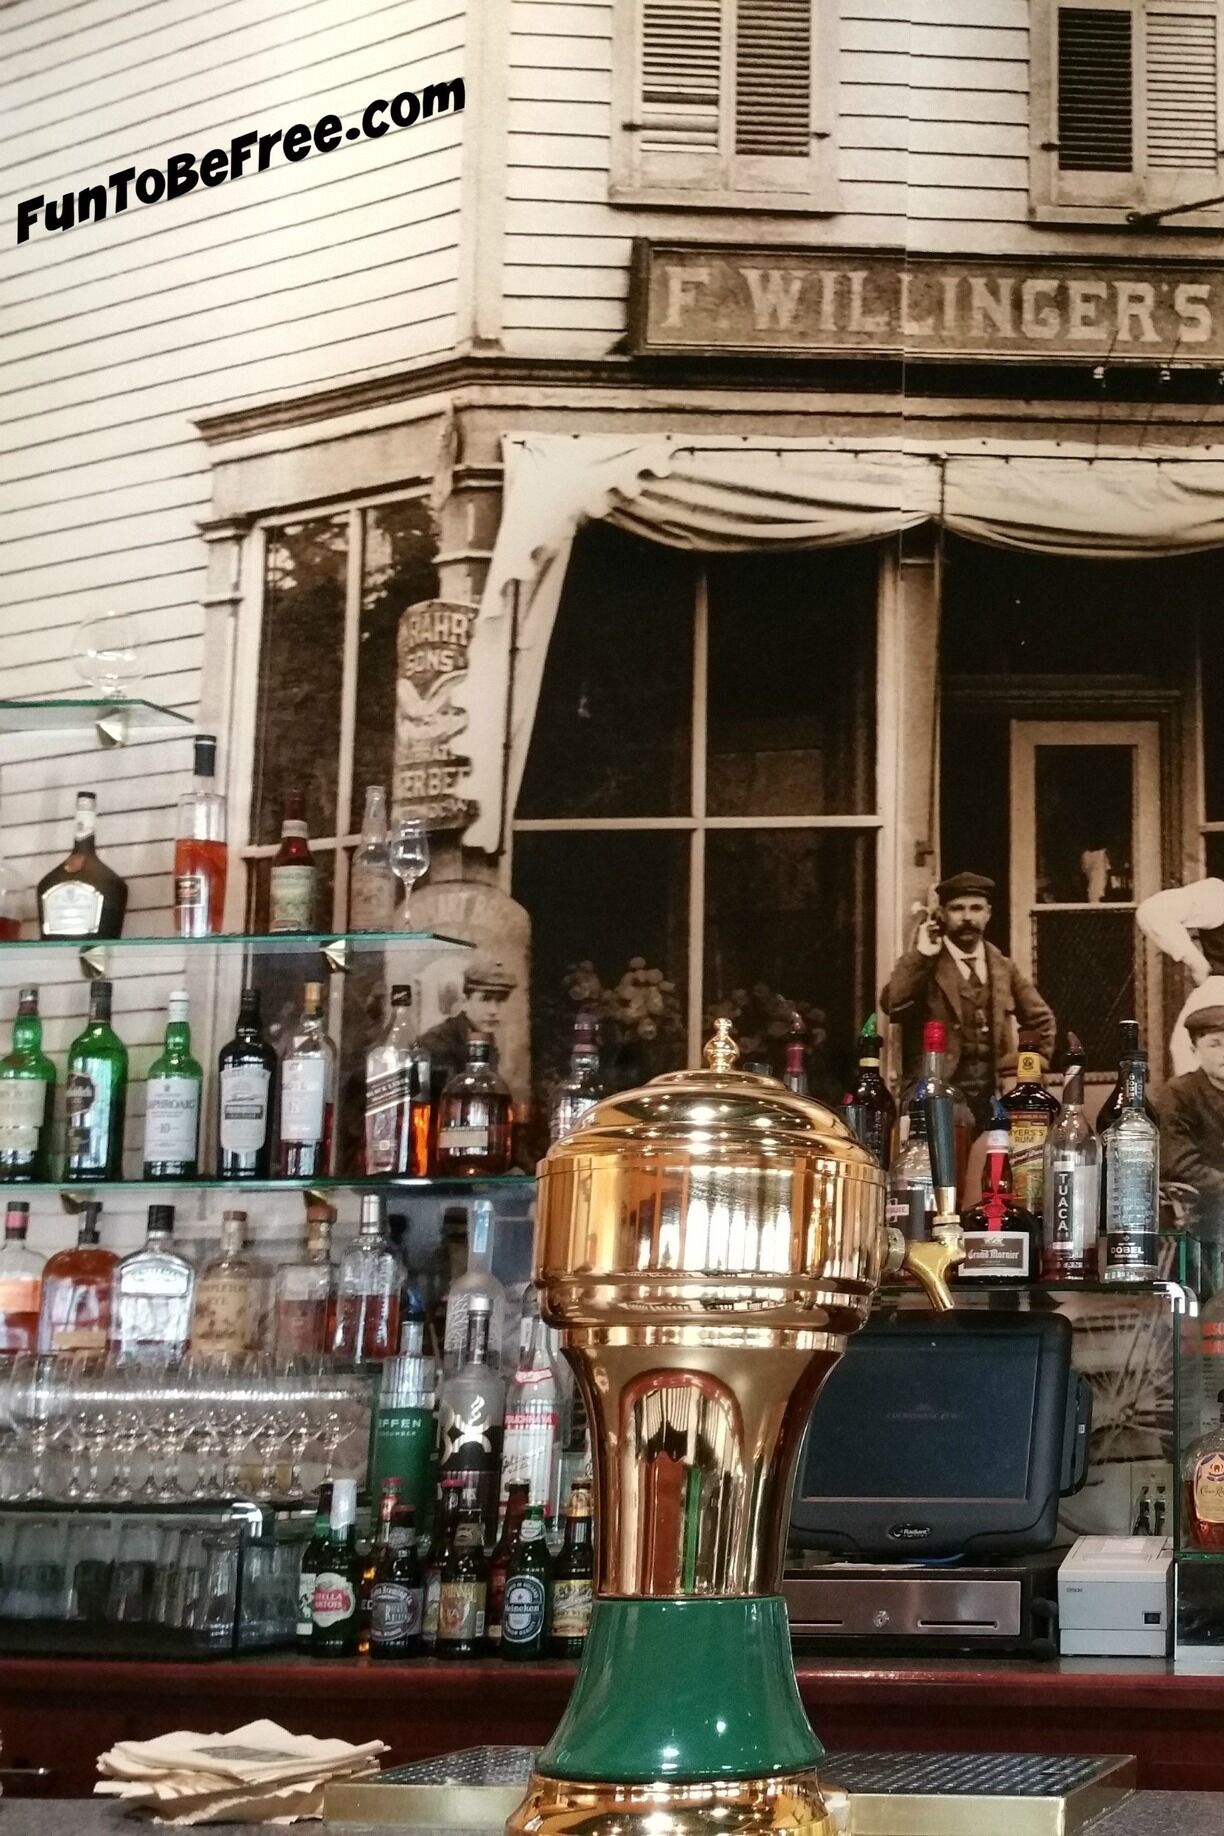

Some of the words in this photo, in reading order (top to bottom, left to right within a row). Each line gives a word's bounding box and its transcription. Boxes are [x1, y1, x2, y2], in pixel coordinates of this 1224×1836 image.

[738, 266, 1213, 344] WILLINGER'S
[1057, 1173, 1069, 1231] TUACA
[1111, 1246, 1145, 1254] DOBEL
